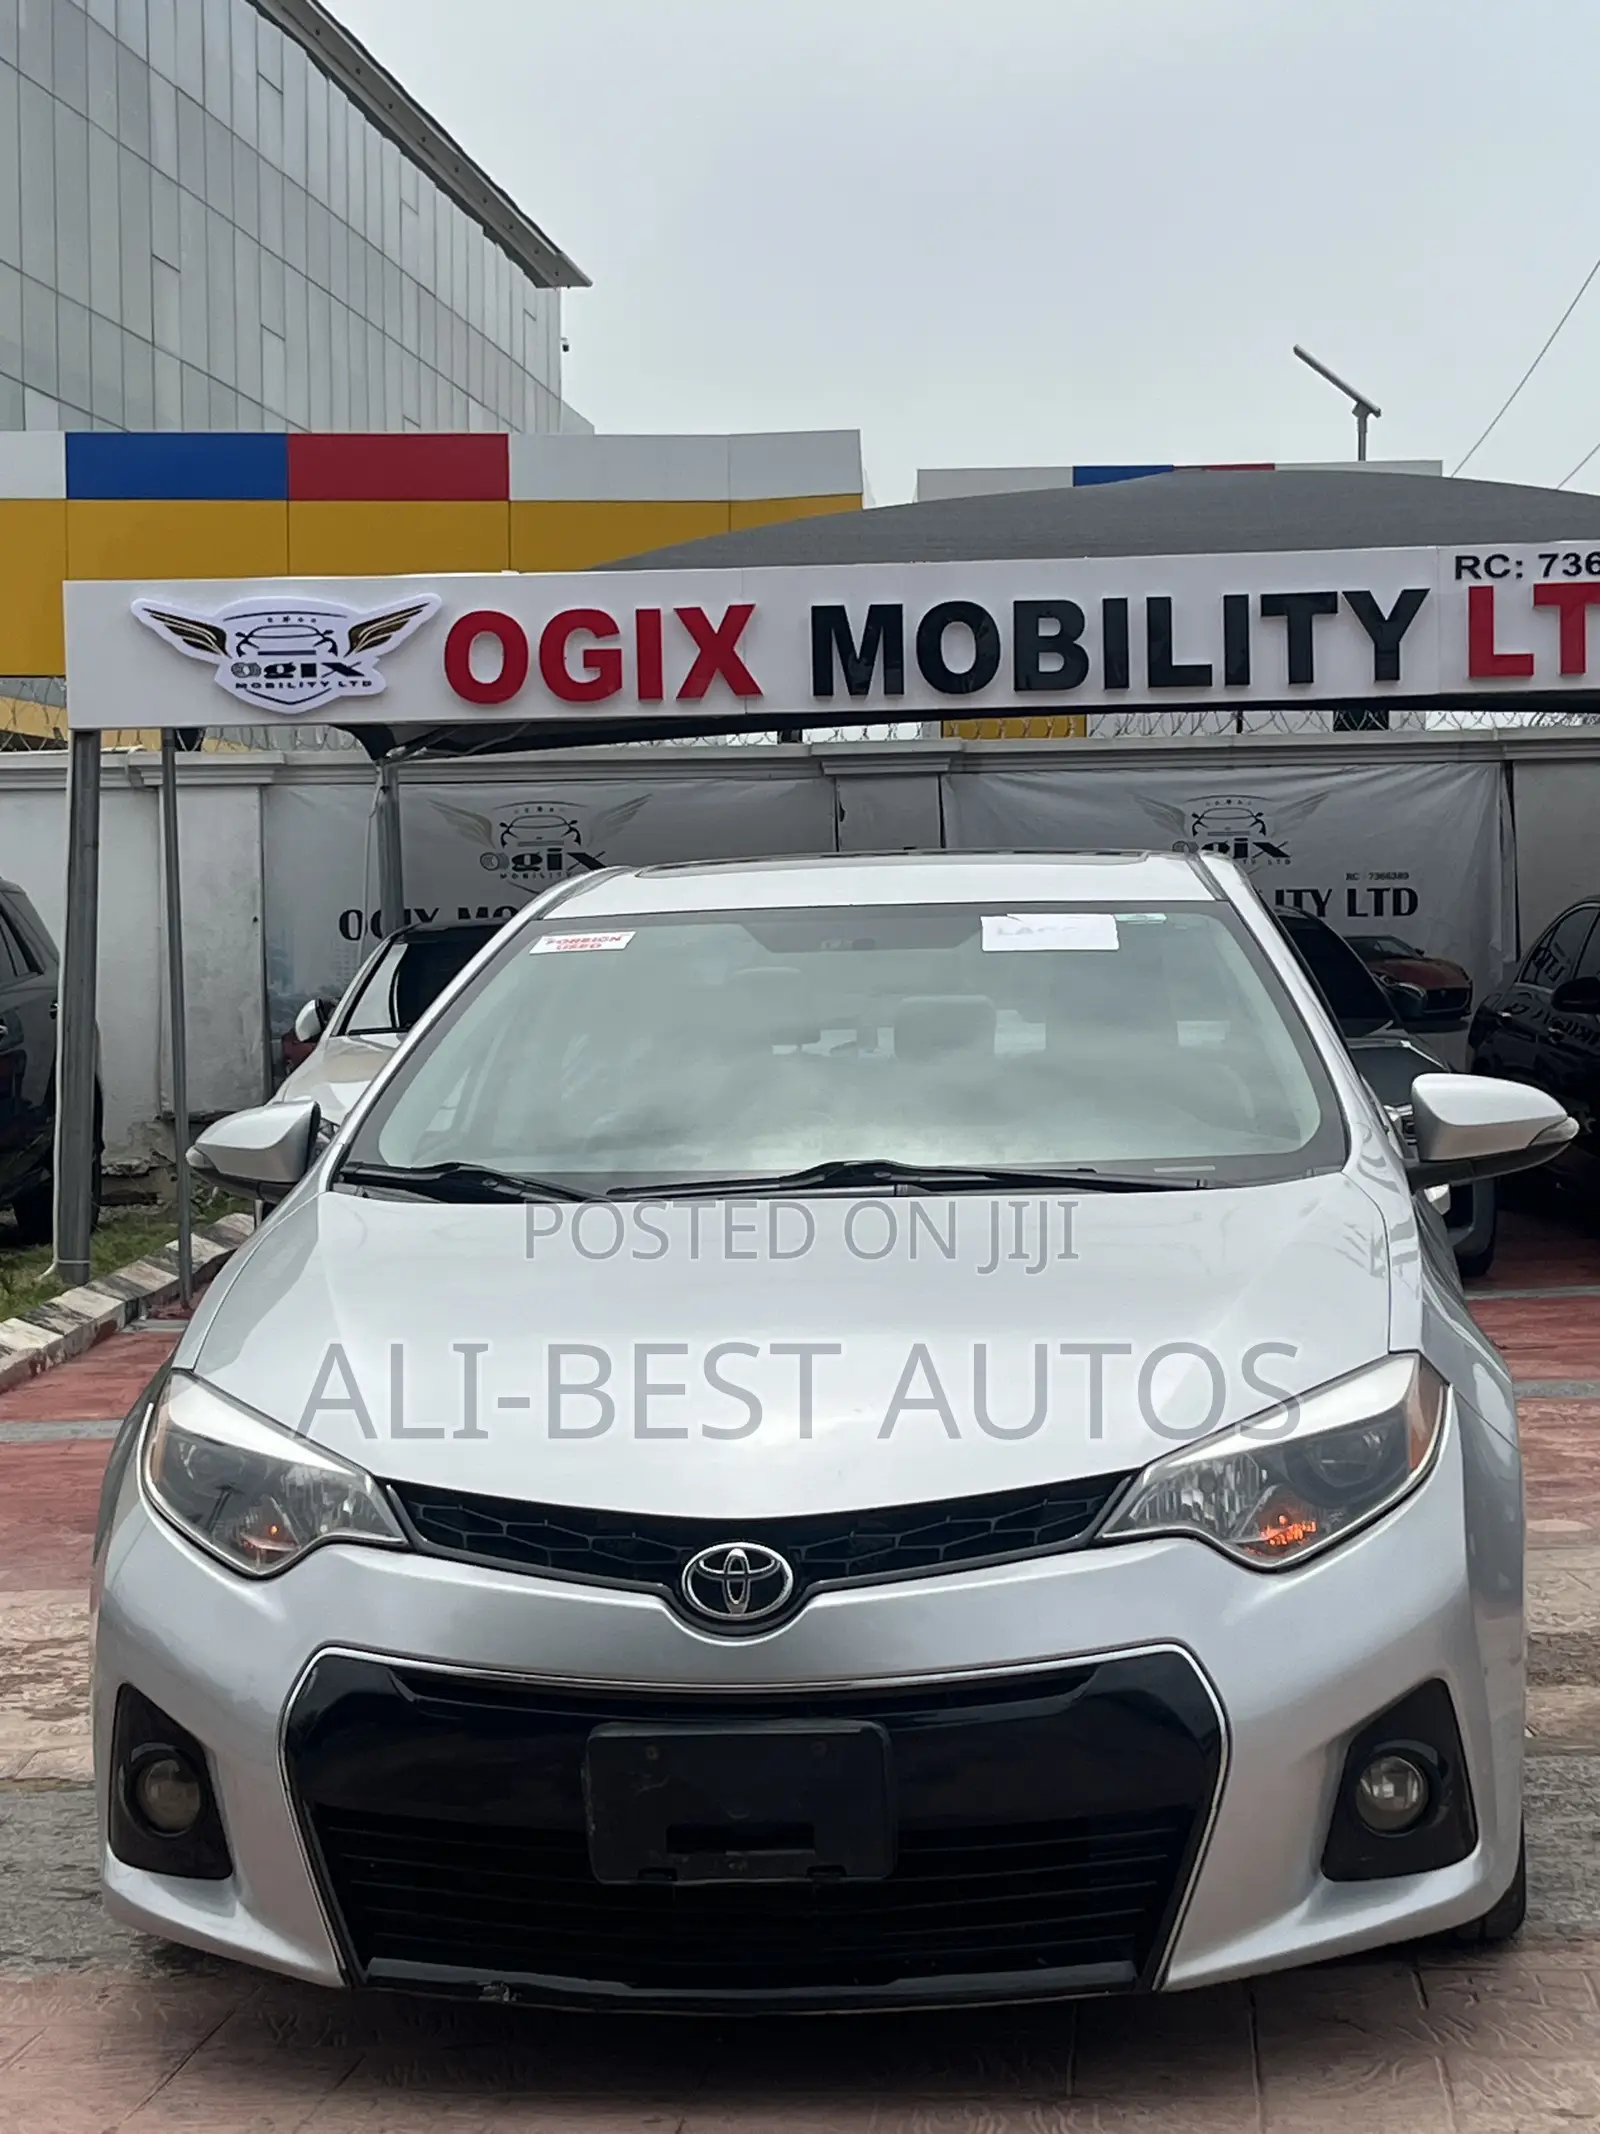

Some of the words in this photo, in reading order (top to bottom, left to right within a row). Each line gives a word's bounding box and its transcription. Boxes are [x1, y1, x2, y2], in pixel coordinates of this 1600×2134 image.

[1455, 554, 1523, 580] RC:
[1538, 552, 1600, 578] 736
[444, 603, 763, 704] OGIX
[811, 587, 1429, 698] MOBILITY
[1468, 581, 1600, 677] LT
[235, 680, 330, 689] MOBILITY
[338, 680, 373, 688] LTD
[1347, 887, 1419, 917] LTD
